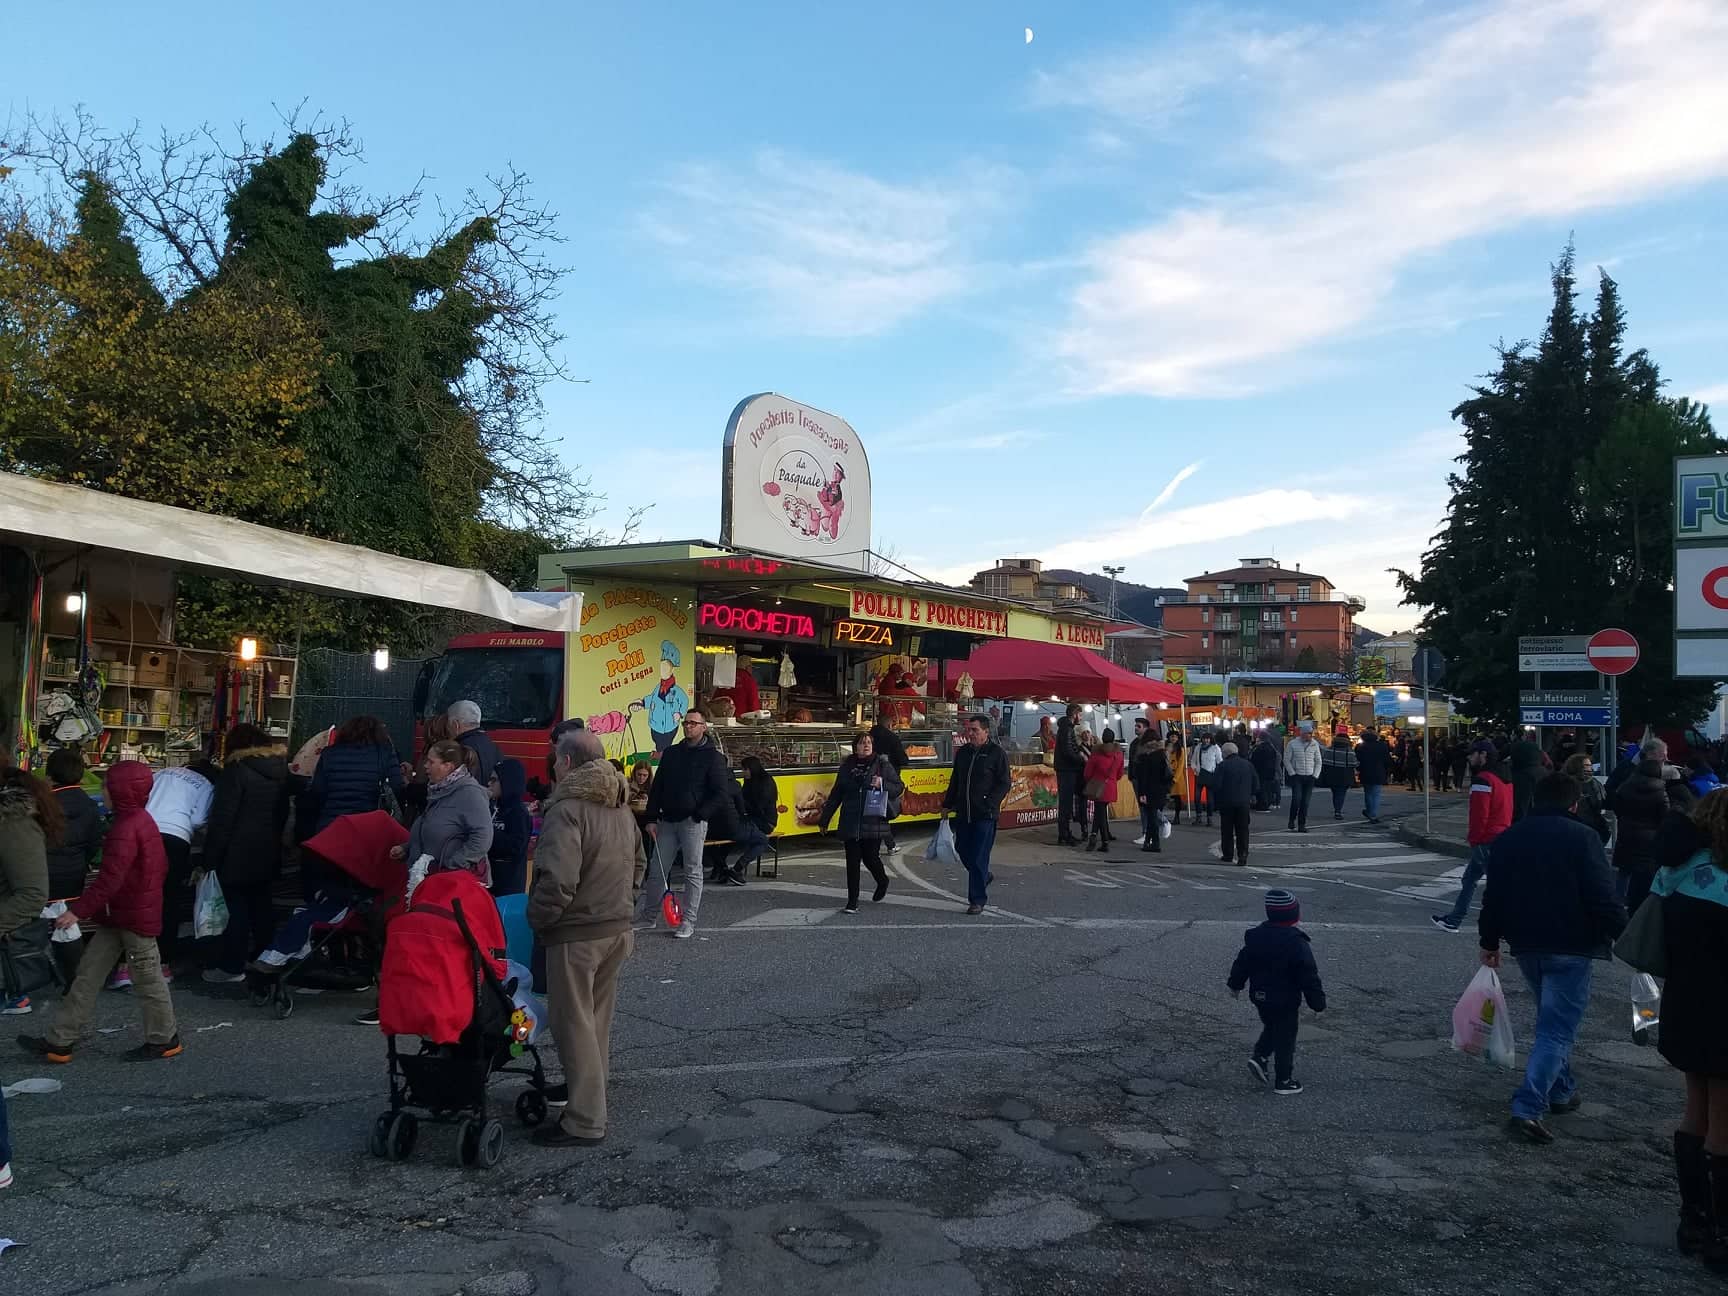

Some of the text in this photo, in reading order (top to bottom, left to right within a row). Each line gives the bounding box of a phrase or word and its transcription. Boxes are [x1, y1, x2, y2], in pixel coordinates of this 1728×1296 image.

[796, 457, 806, 469] da
[779, 468, 821, 492] Pasquale
[700, 603, 815, 637] PORCHETTA
[852, 589, 1008, 633] POLLI E PORCHETTA
[581, 616, 656, 652] Porchetta
[835, 621, 893, 646] PIZZA
[1055, 623, 1103, 646] A LEGNA
[618, 641, 628, 653] e
[607, 649, 646, 677] Polli
[600, 680, 621, 694] Cotti
[630, 667, 654, 681] Legna
[1520, 693, 1586, 702] viale Matteucci
[1548, 712, 1583, 721] ROMA
[1016, 811, 1047, 823] PORCHETTA
